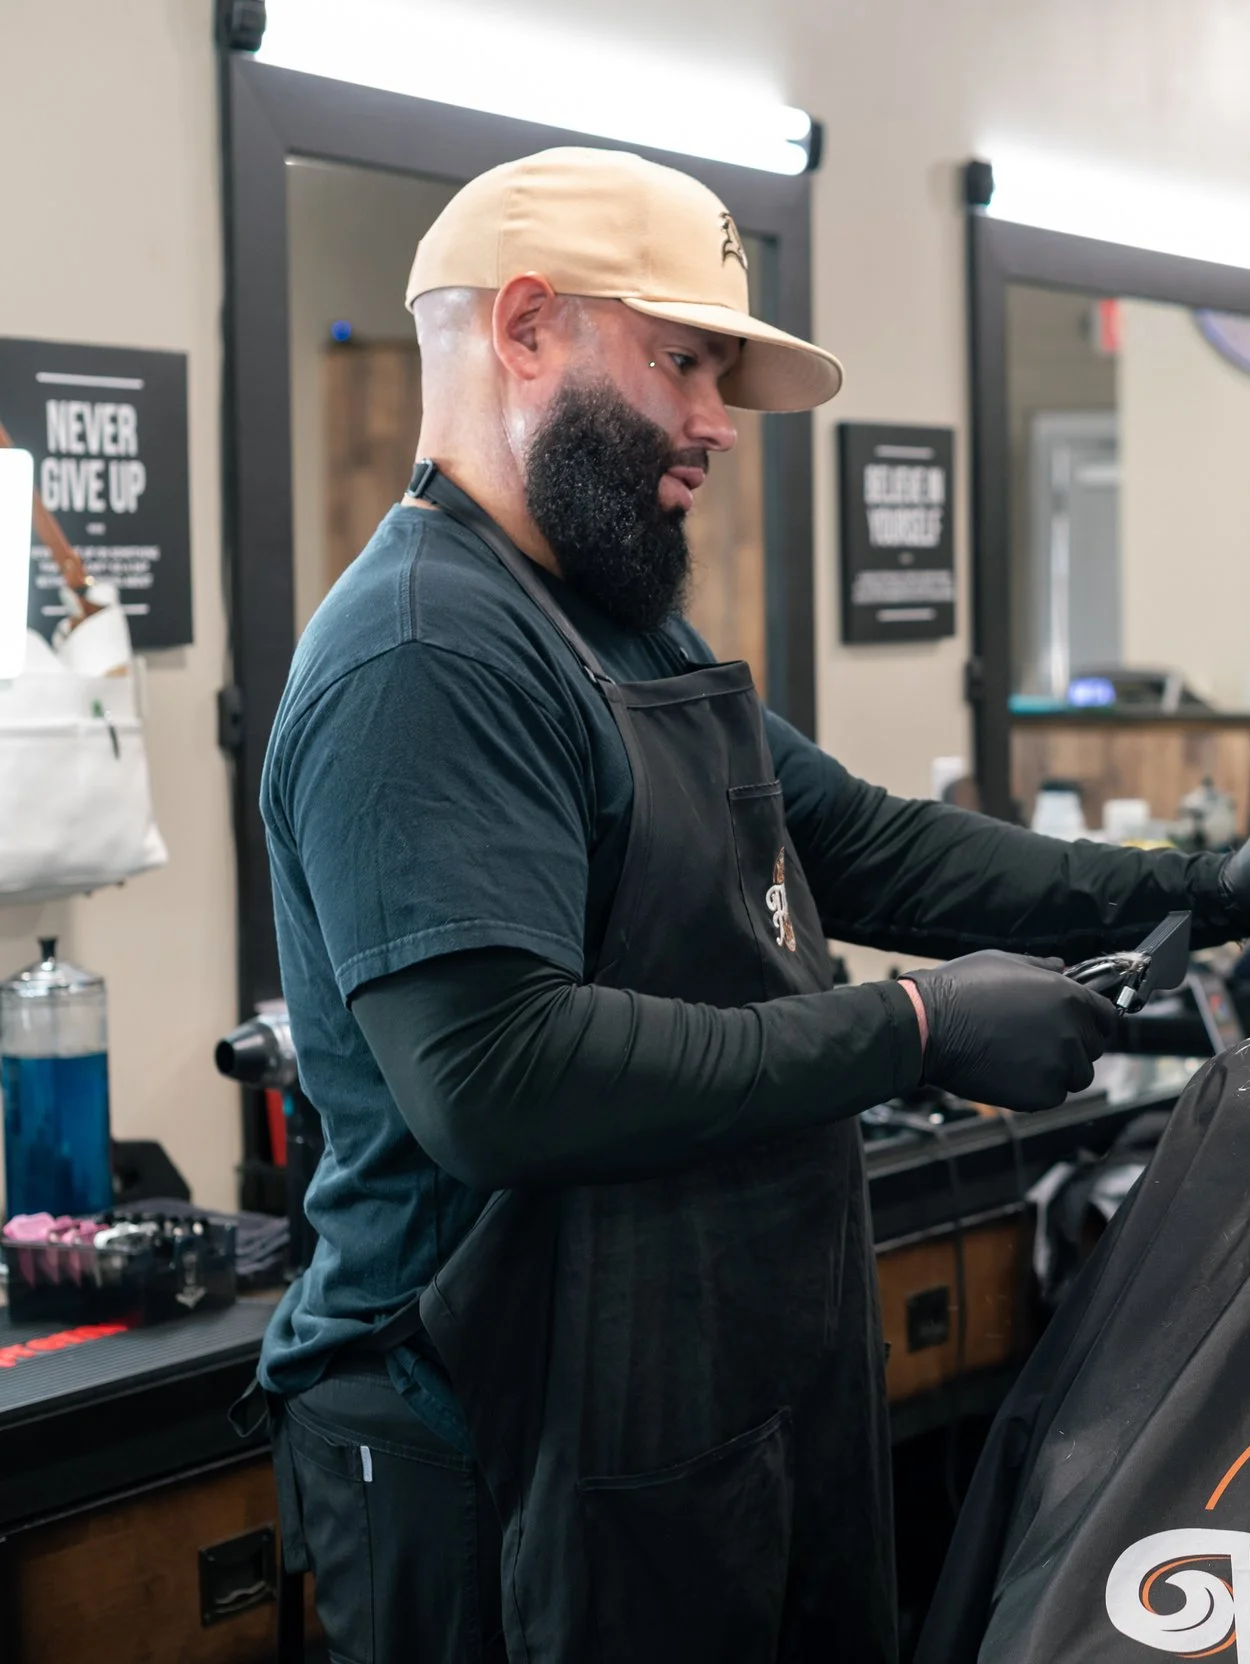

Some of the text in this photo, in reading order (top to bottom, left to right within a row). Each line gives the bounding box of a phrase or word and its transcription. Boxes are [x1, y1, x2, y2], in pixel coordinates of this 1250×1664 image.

[45, 399, 139, 457] NEVER
[40, 457, 146, 513] GIVE UP
